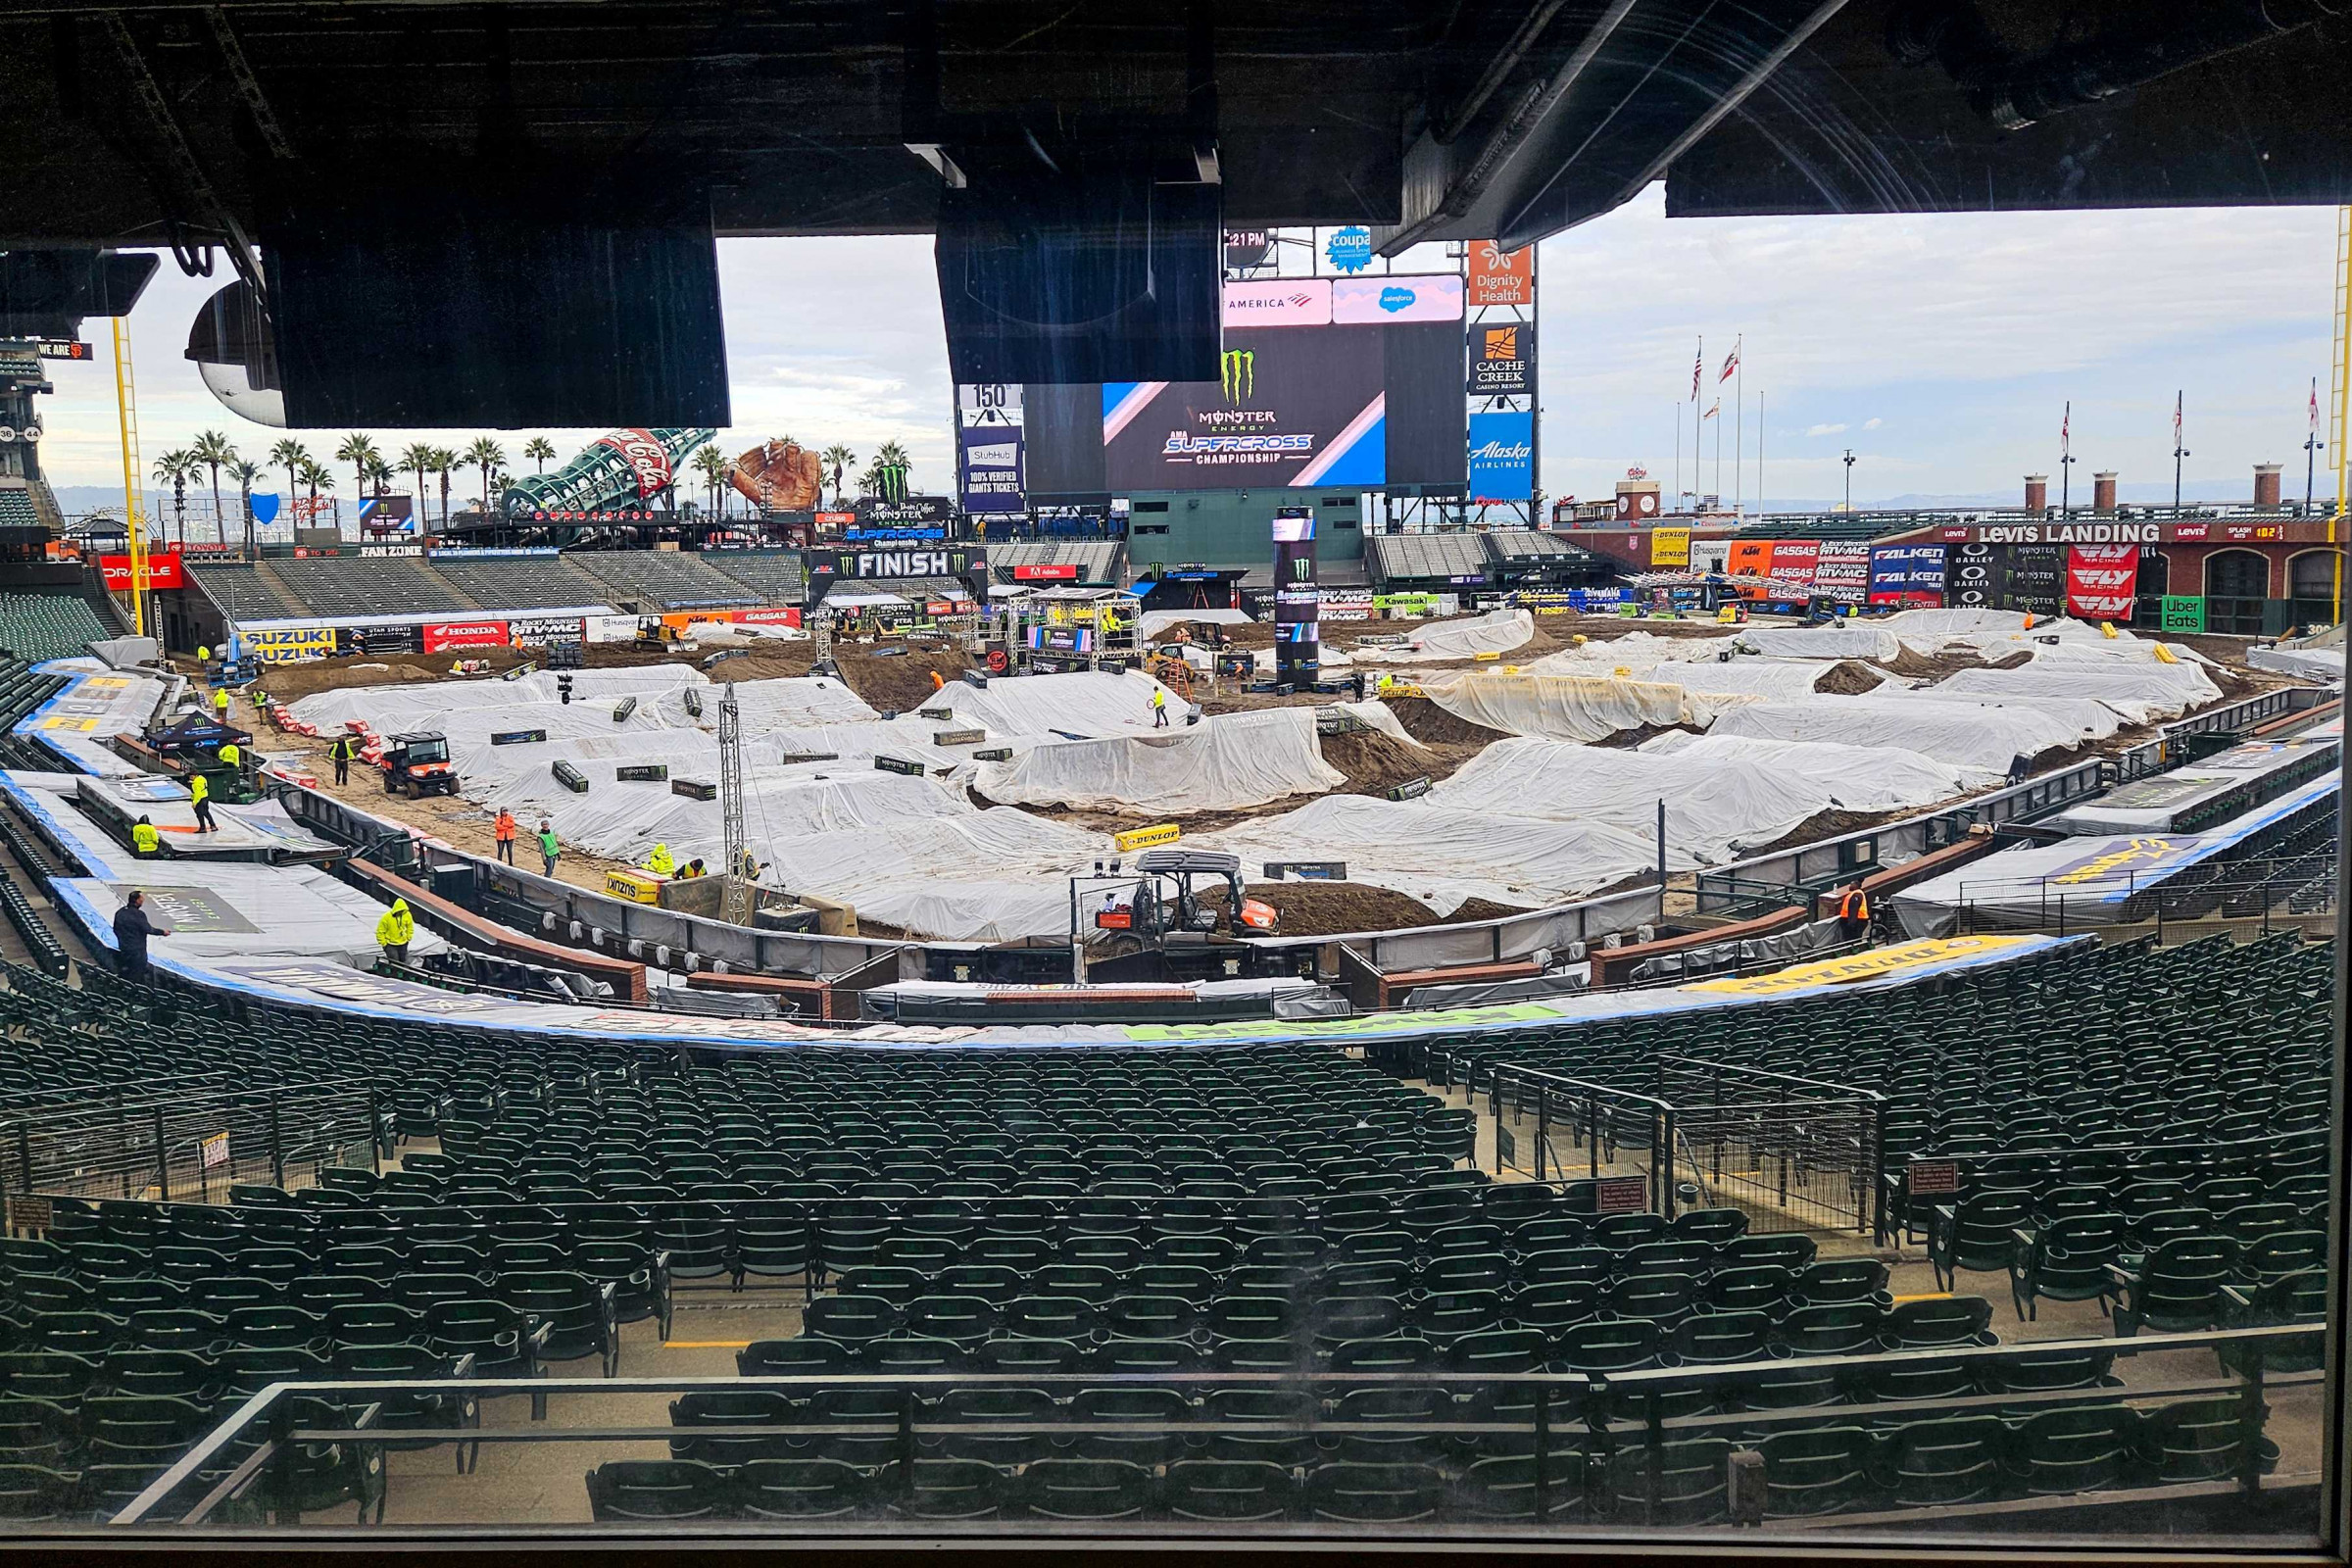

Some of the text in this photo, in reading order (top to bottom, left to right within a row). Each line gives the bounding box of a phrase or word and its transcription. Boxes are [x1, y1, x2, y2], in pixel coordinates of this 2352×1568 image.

[1248, 232, 1265, 245] PM
[1332, 233, 1370, 248] coupa
[1477, 274, 1523, 290] Dignity
[1479, 289, 1521, 302] Health
[1229, 299, 1285, 309] AMERICA
[39, 344, 52, 355] WE
[53, 345, 70, 356] ARE
[1476, 361, 1526, 371] CACHE
[1477, 371, 1524, 382] CREEK
[973, 383, 1006, 408] 150
[1199, 410, 1277, 425] MONSTER
[1165, 435, 1313, 452] SUPERCROSS
[974, 451, 1010, 460] StubHub
[1470, 440, 1532, 460] Alaska
[1196, 453, 1281, 465] CHAMPIONSHIP
[969, 470, 1016, 482] 100% VERIFIED
[968, 482, 1019, 494] GIANTS TICKETS
[870, 510, 923, 519] MONSTER
[846, 528, 945, 540] SUPERCROSS
[2046, 524, 2160, 542] LANDING
[2256, 527, 2276, 537] 102
[360, 546, 422, 558] FAN ZONE
[1741, 545, 1761, 556] KTM
[1774, 546, 1817, 556] GASGAS
[1875, 548, 1944, 561] FALKEN
[2018, 546, 2056, 555] MONSTER
[2073, 544, 2135, 559] FLY
[858, 551, 949, 577] FINISH
[1771, 567, 1813, 577] GASGAS
[2072, 569, 2133, 584] FLY
[1768, 589, 1810, 599] GASGAS
[1384, 597, 1428, 606] Kawasaki
[2071, 595, 2132, 611] FLY
[2166, 600, 2198, 612] Uber
[745, 612, 788, 621] GASGAS
[2166, 614, 2199, 627] Eats
[448, 626, 499, 635] HONDA
[245, 630, 332, 645] SUZUKI
[1136, 830, 1179, 844] DUNLOP
[607, 877, 636, 898] SUZUKI
